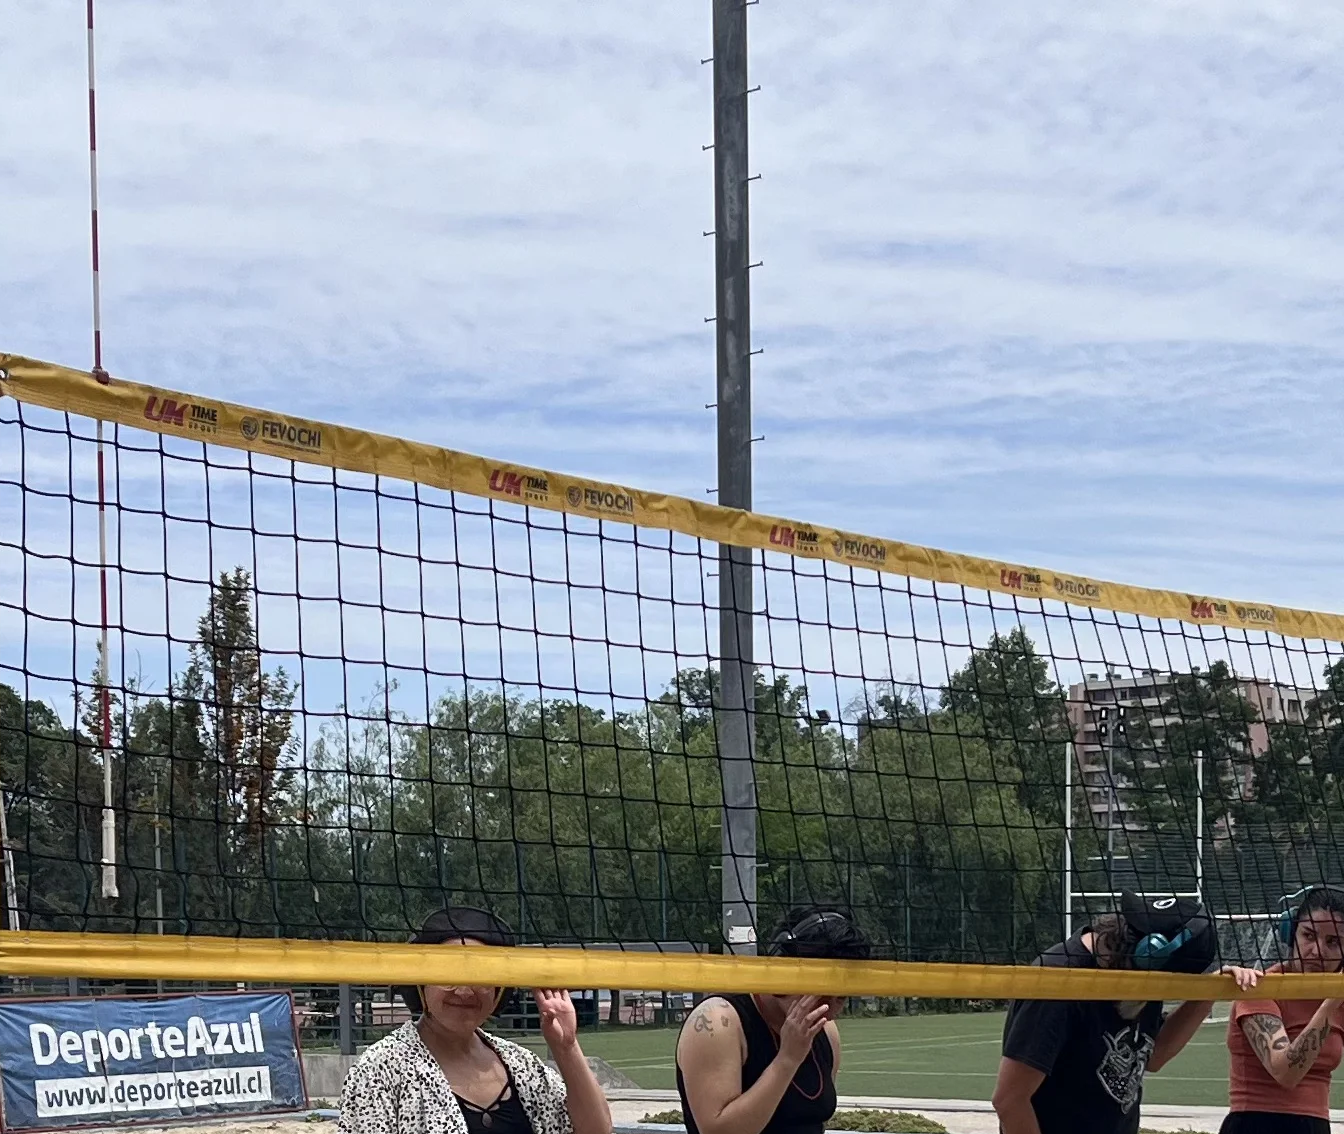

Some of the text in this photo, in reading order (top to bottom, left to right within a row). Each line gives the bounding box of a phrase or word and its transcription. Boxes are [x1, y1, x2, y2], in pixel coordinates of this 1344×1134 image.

[144, 396, 218, 427] UK TIME
[262, 420, 321, 447] FEVOCHI
[489, 469, 548, 497] UK TIME
[584, 488, 633, 512] FEVOCHI
[769, 524, 795, 548] UK
[844, 540, 885, 560] FEVOCHI
[28, 1012, 265, 1073] DeporteAzul
[44, 1070, 262, 1109] www.deporteazul.cl
